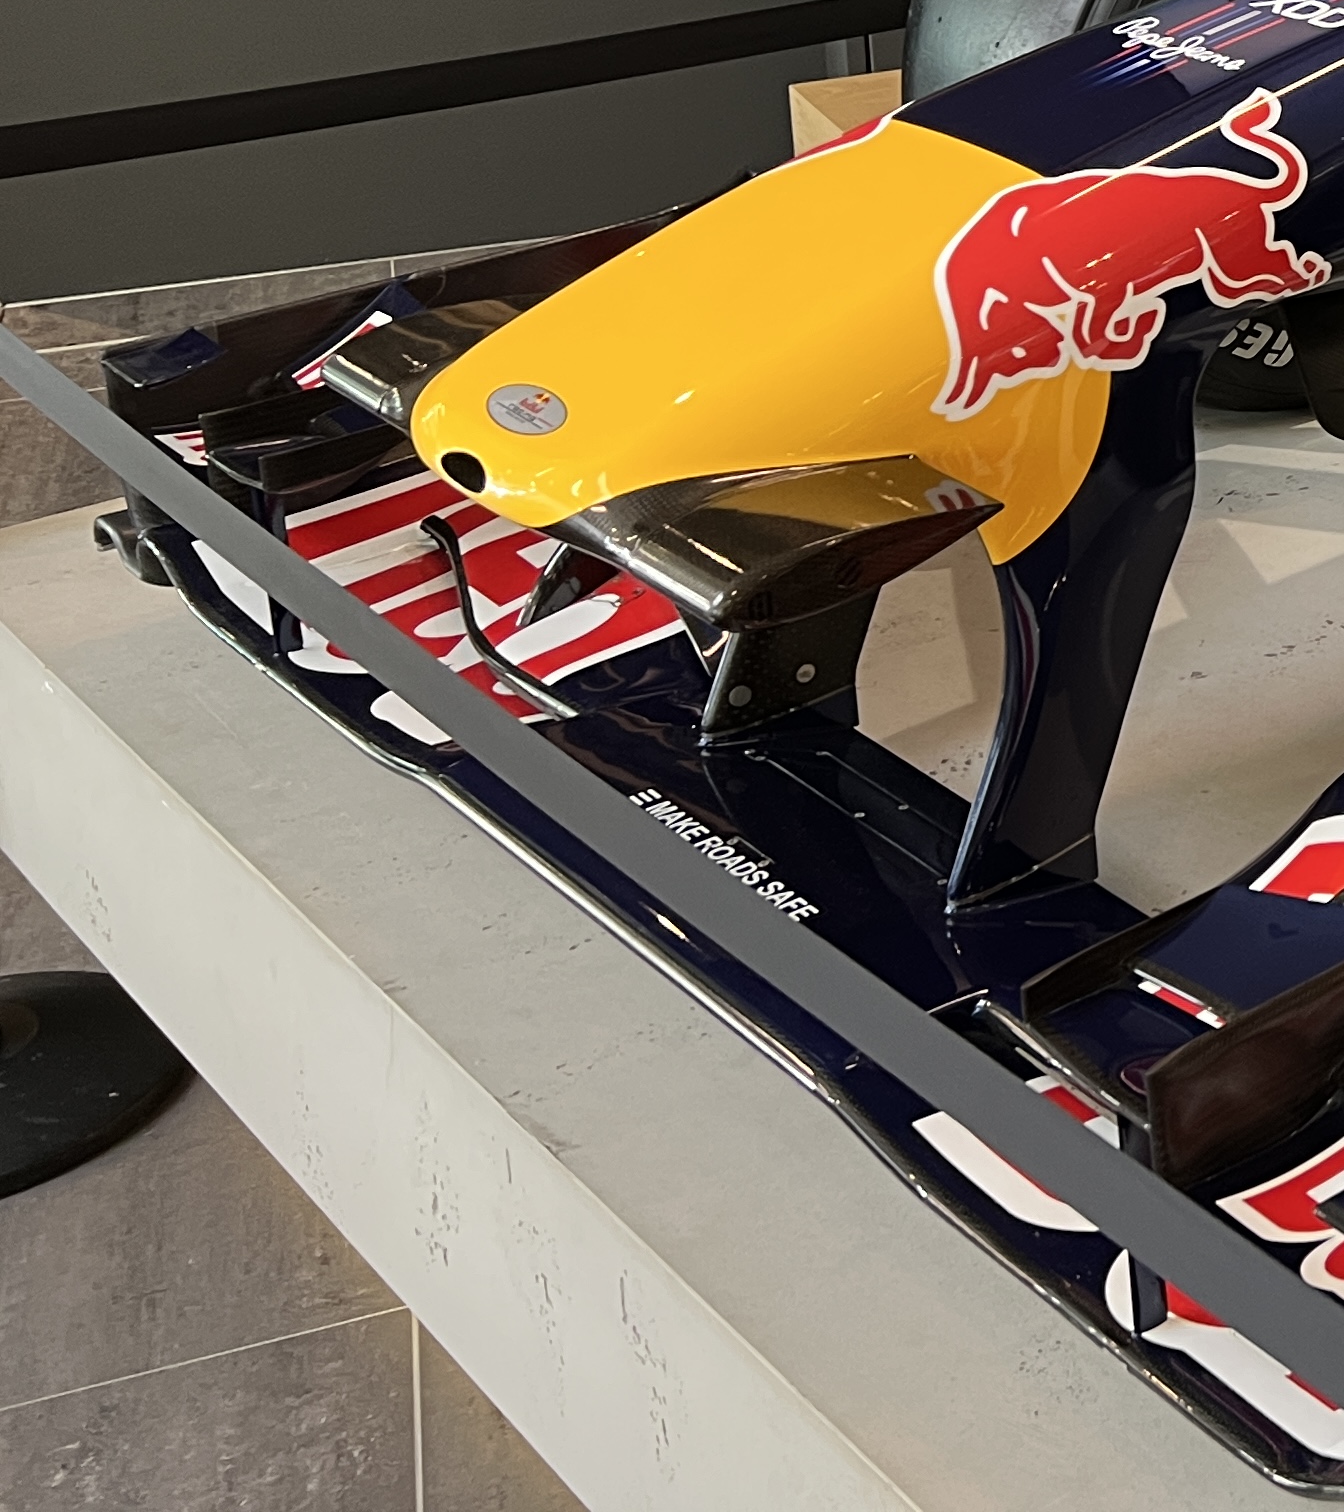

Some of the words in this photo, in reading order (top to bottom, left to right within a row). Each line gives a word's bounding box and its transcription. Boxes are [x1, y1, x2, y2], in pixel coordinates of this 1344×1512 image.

[1112, 16, 1169, 49] Pepe
[1150, 35, 1246, 72] Jeans
[645, 800, 710, 842] MAKE
[693, 835, 770, 885] ROADS
[756, 881, 820, 922] SAFE
